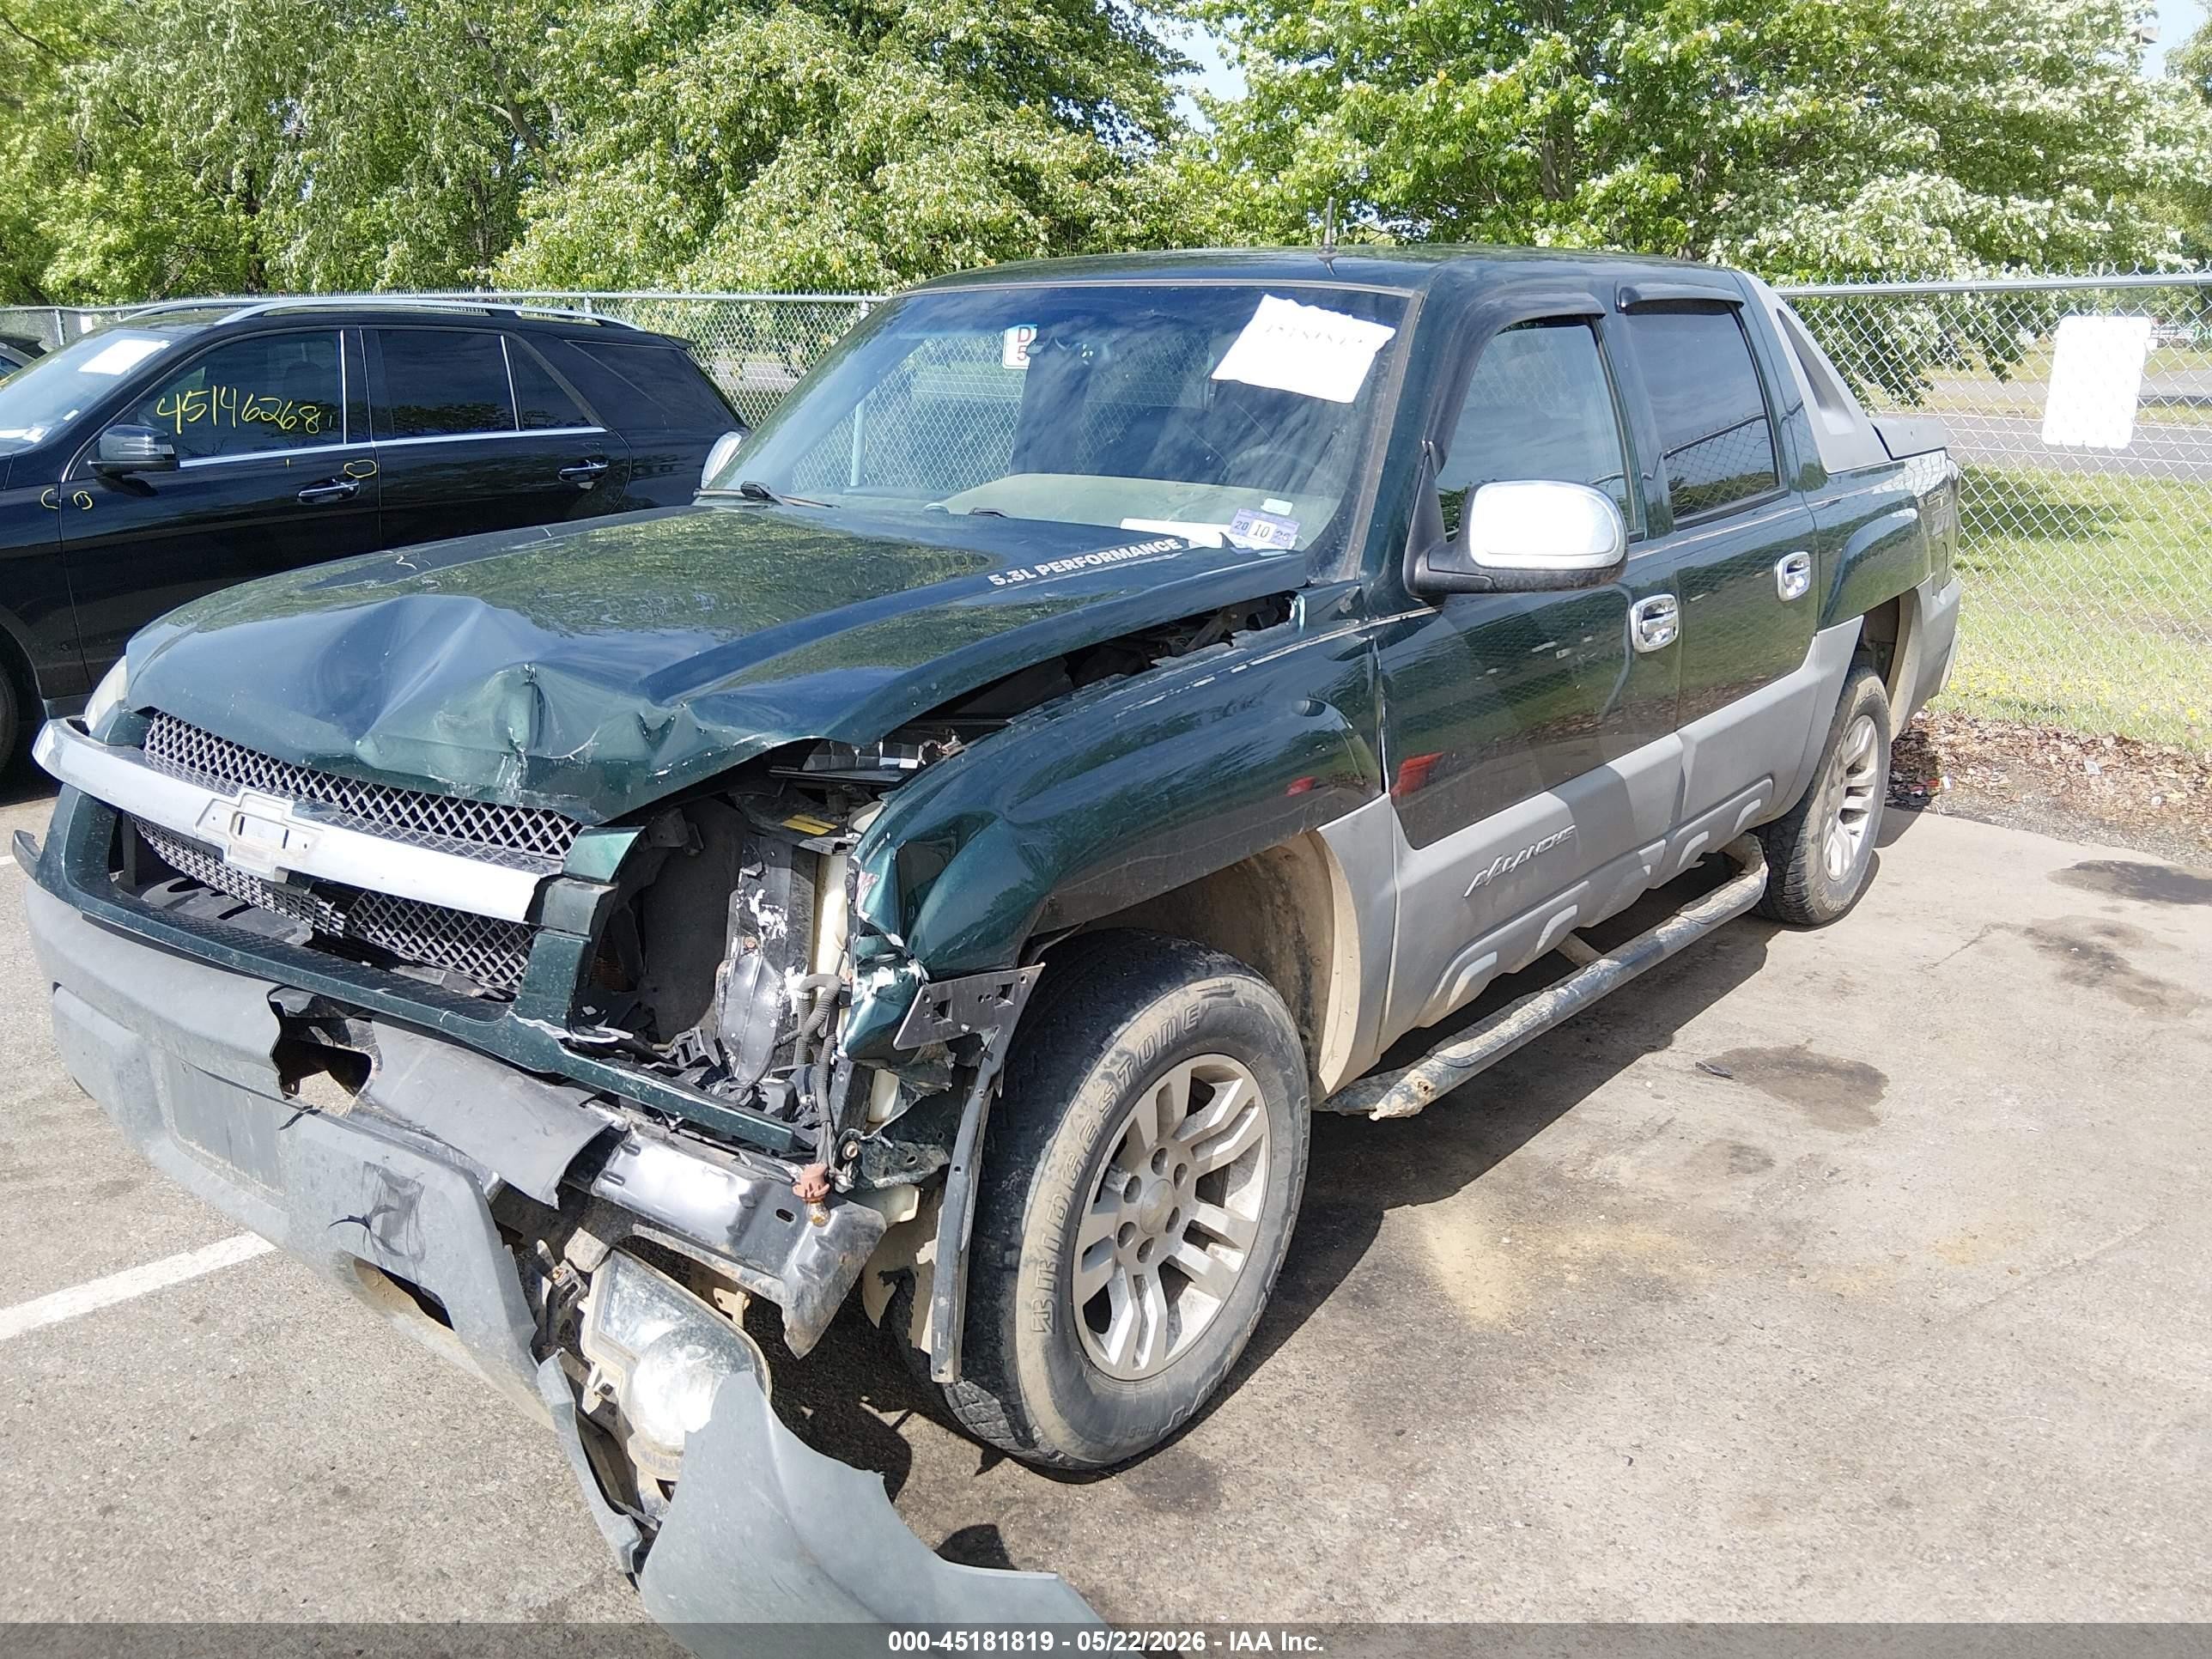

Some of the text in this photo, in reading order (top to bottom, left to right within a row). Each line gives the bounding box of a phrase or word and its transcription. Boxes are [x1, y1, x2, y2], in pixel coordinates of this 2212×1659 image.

[1234, 520, 1250, 532] 20
[1253, 523, 1271, 538] 10
[988, 538, 1184, 586] 5.3L PERFORMANCE
[1030, 1001, 1202, 1336] BRIDGESTONE
